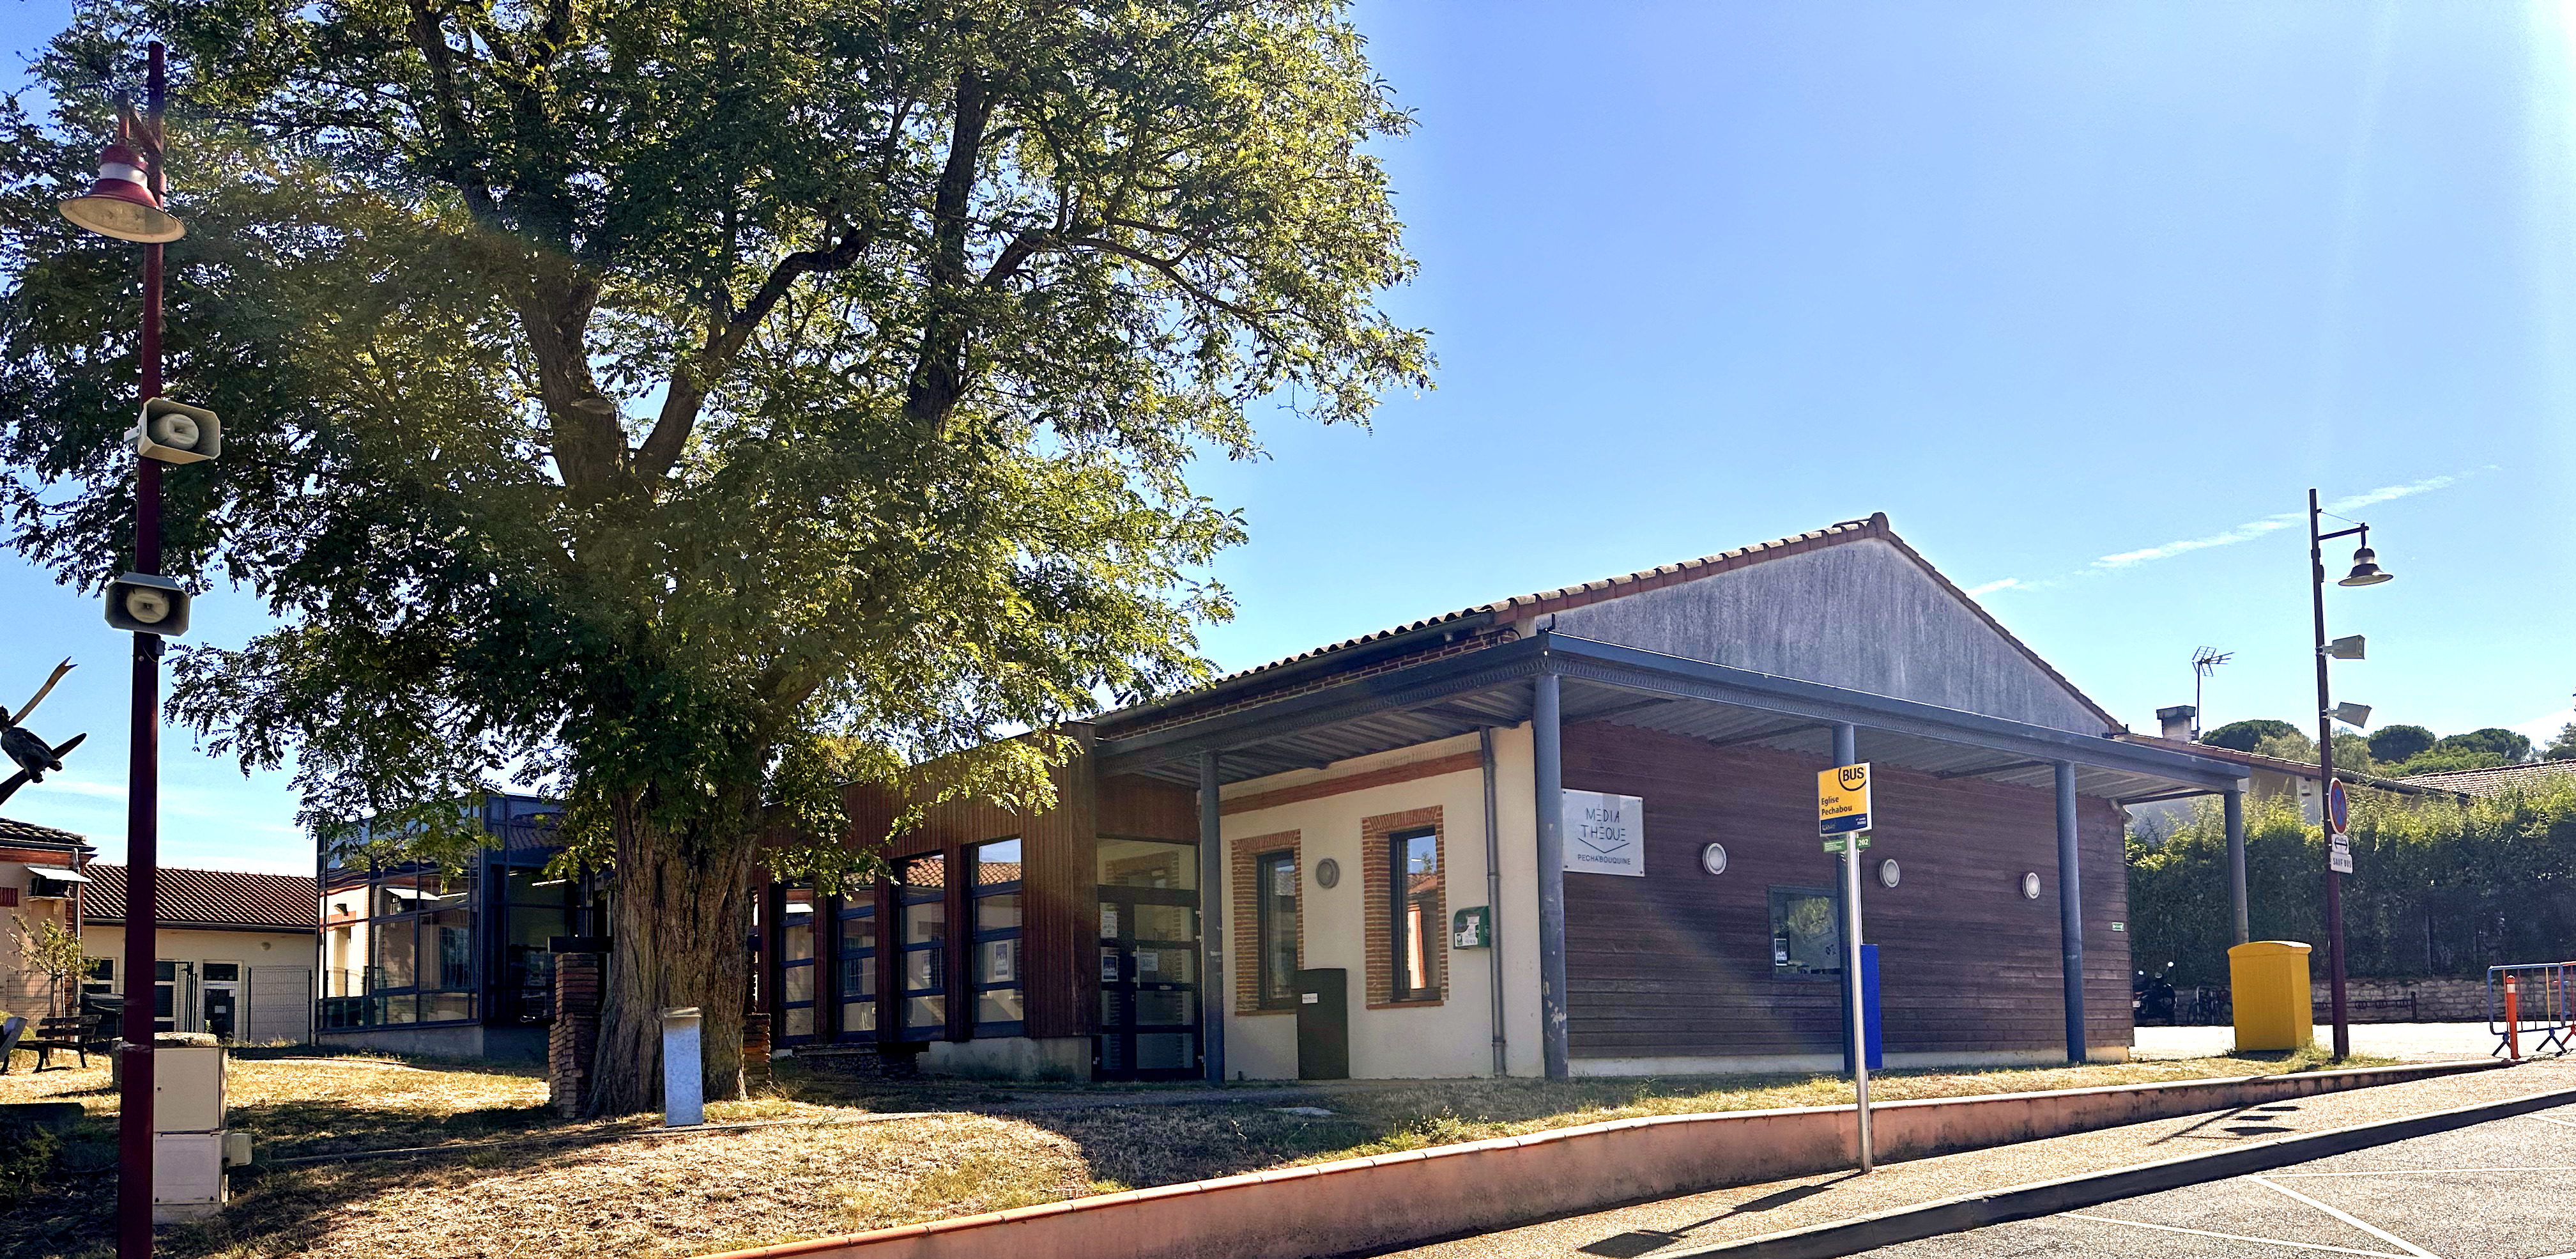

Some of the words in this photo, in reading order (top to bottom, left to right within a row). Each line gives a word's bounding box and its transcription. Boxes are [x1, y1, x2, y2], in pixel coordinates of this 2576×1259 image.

[1843, 767, 1864, 781] BUS
[1821, 796, 1839, 807] Eglise
[1821, 805, 1853, 815] Pechabou
[1577, 854, 1631, 865] PECHABOUQUINE
